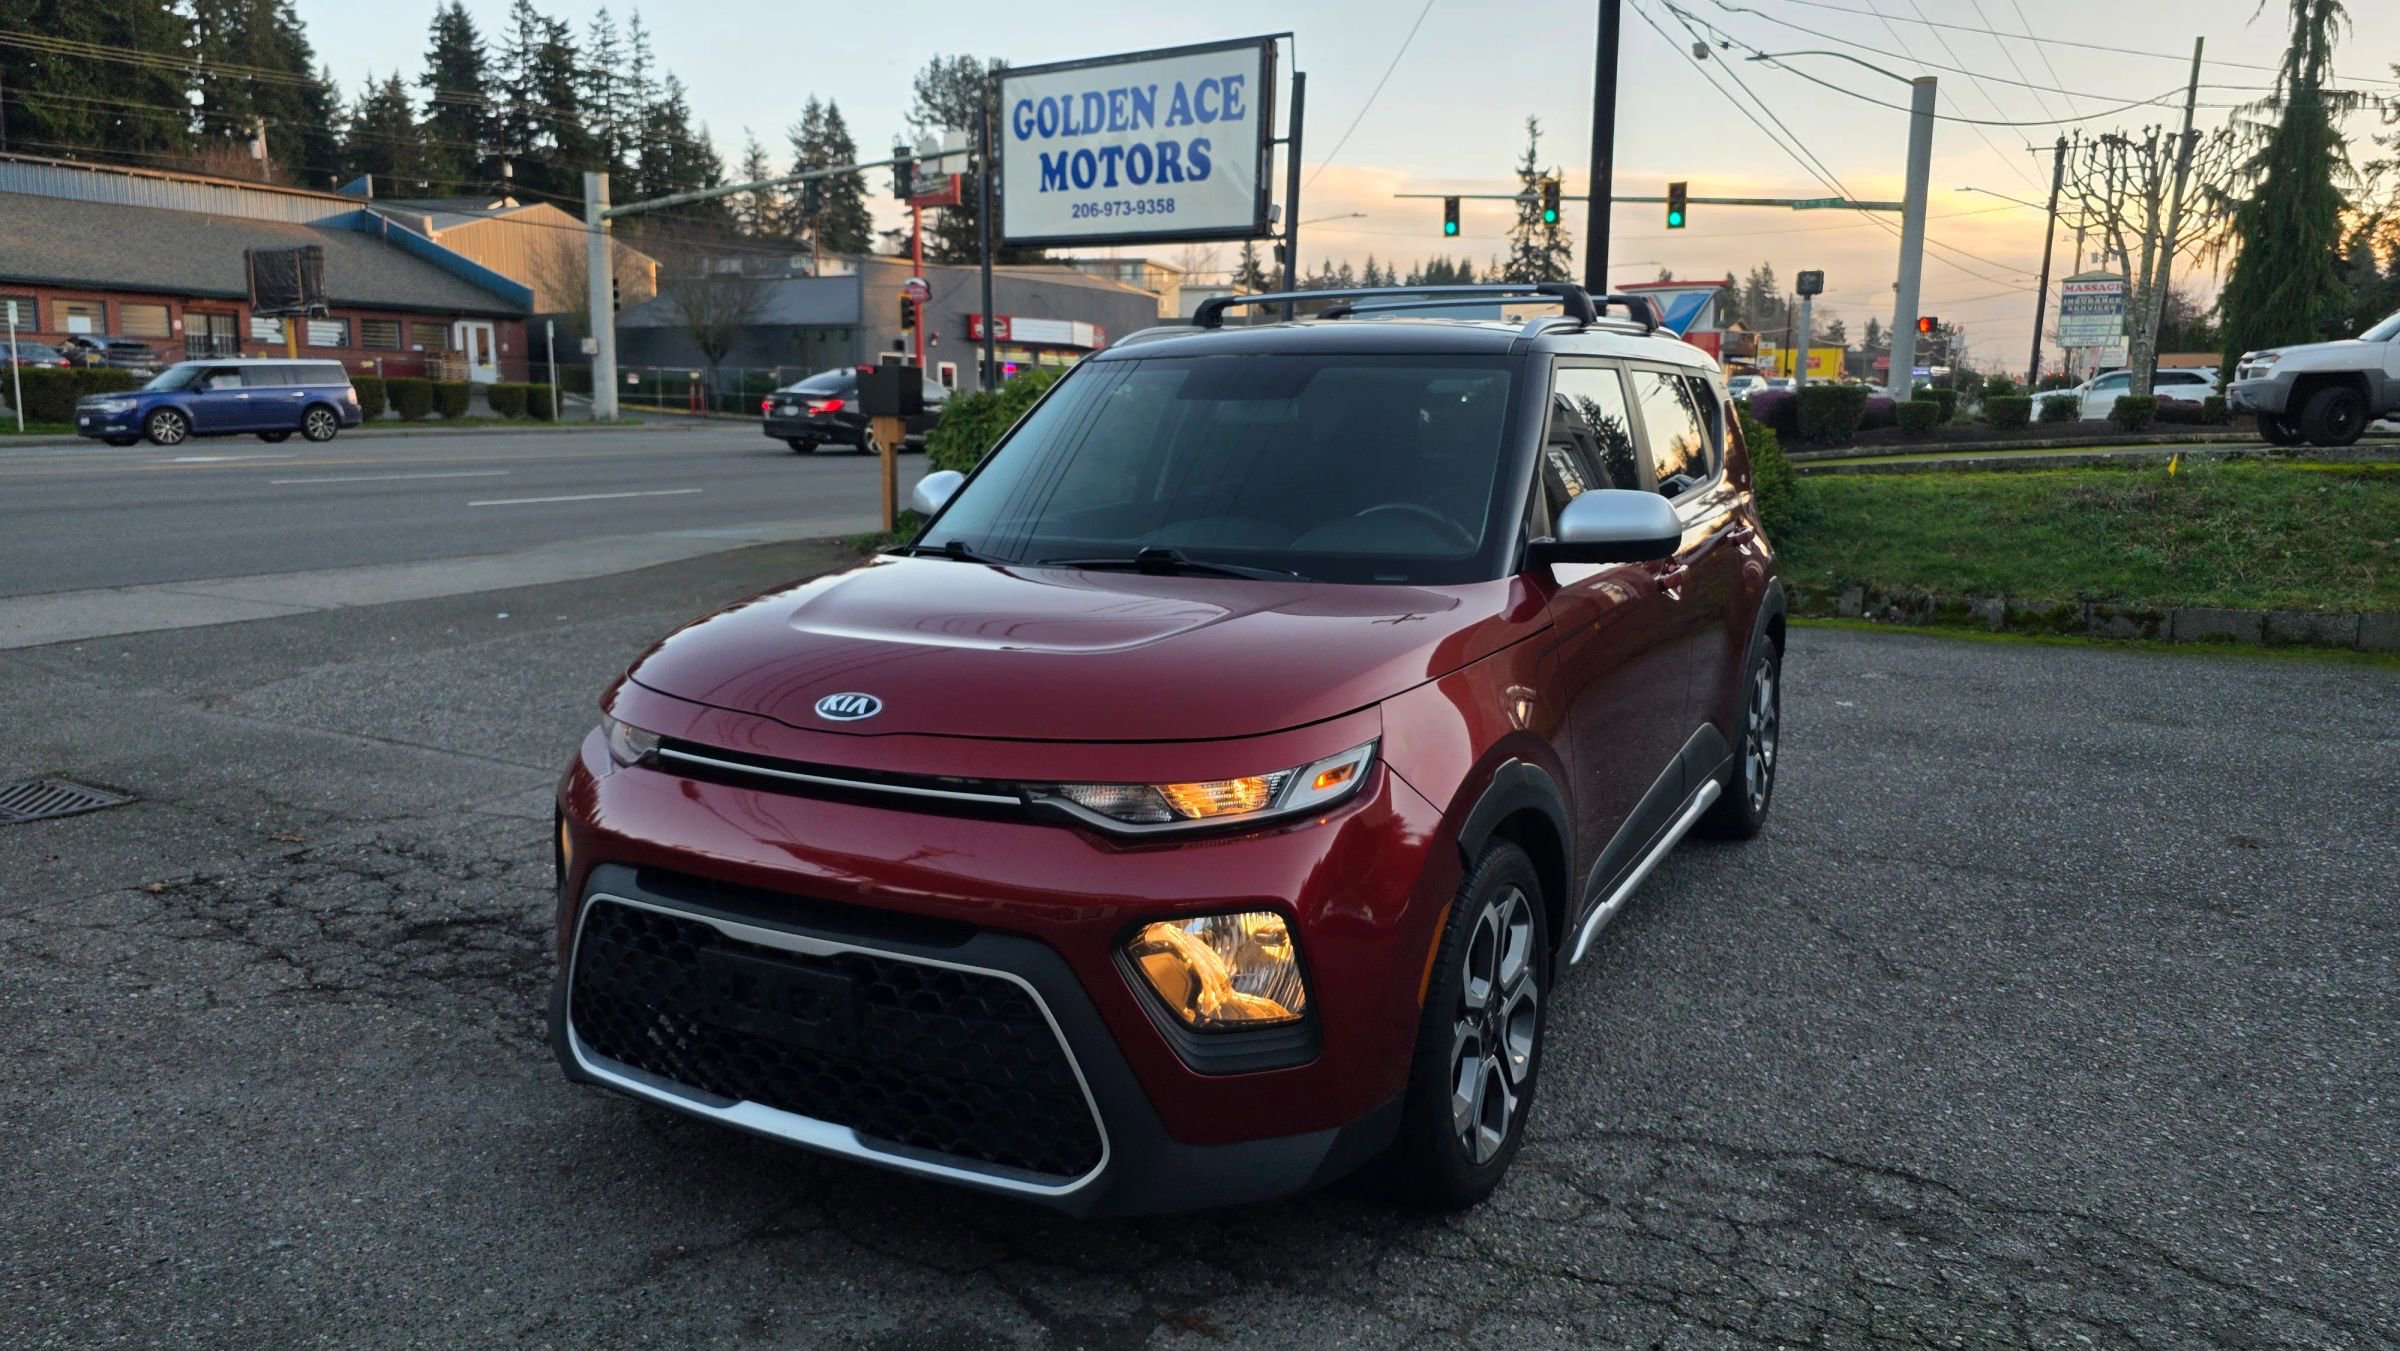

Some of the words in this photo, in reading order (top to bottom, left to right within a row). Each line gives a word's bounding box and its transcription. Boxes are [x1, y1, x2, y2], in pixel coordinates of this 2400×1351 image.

[1013, 84, 1158, 141] GOLDEN
[1164, 73, 1246, 128] ACE
[1039, 137, 1212, 193] MOTORS
[1072, 197, 1175, 219] 206-973-9358
[822, 695, 868, 714] KIA
